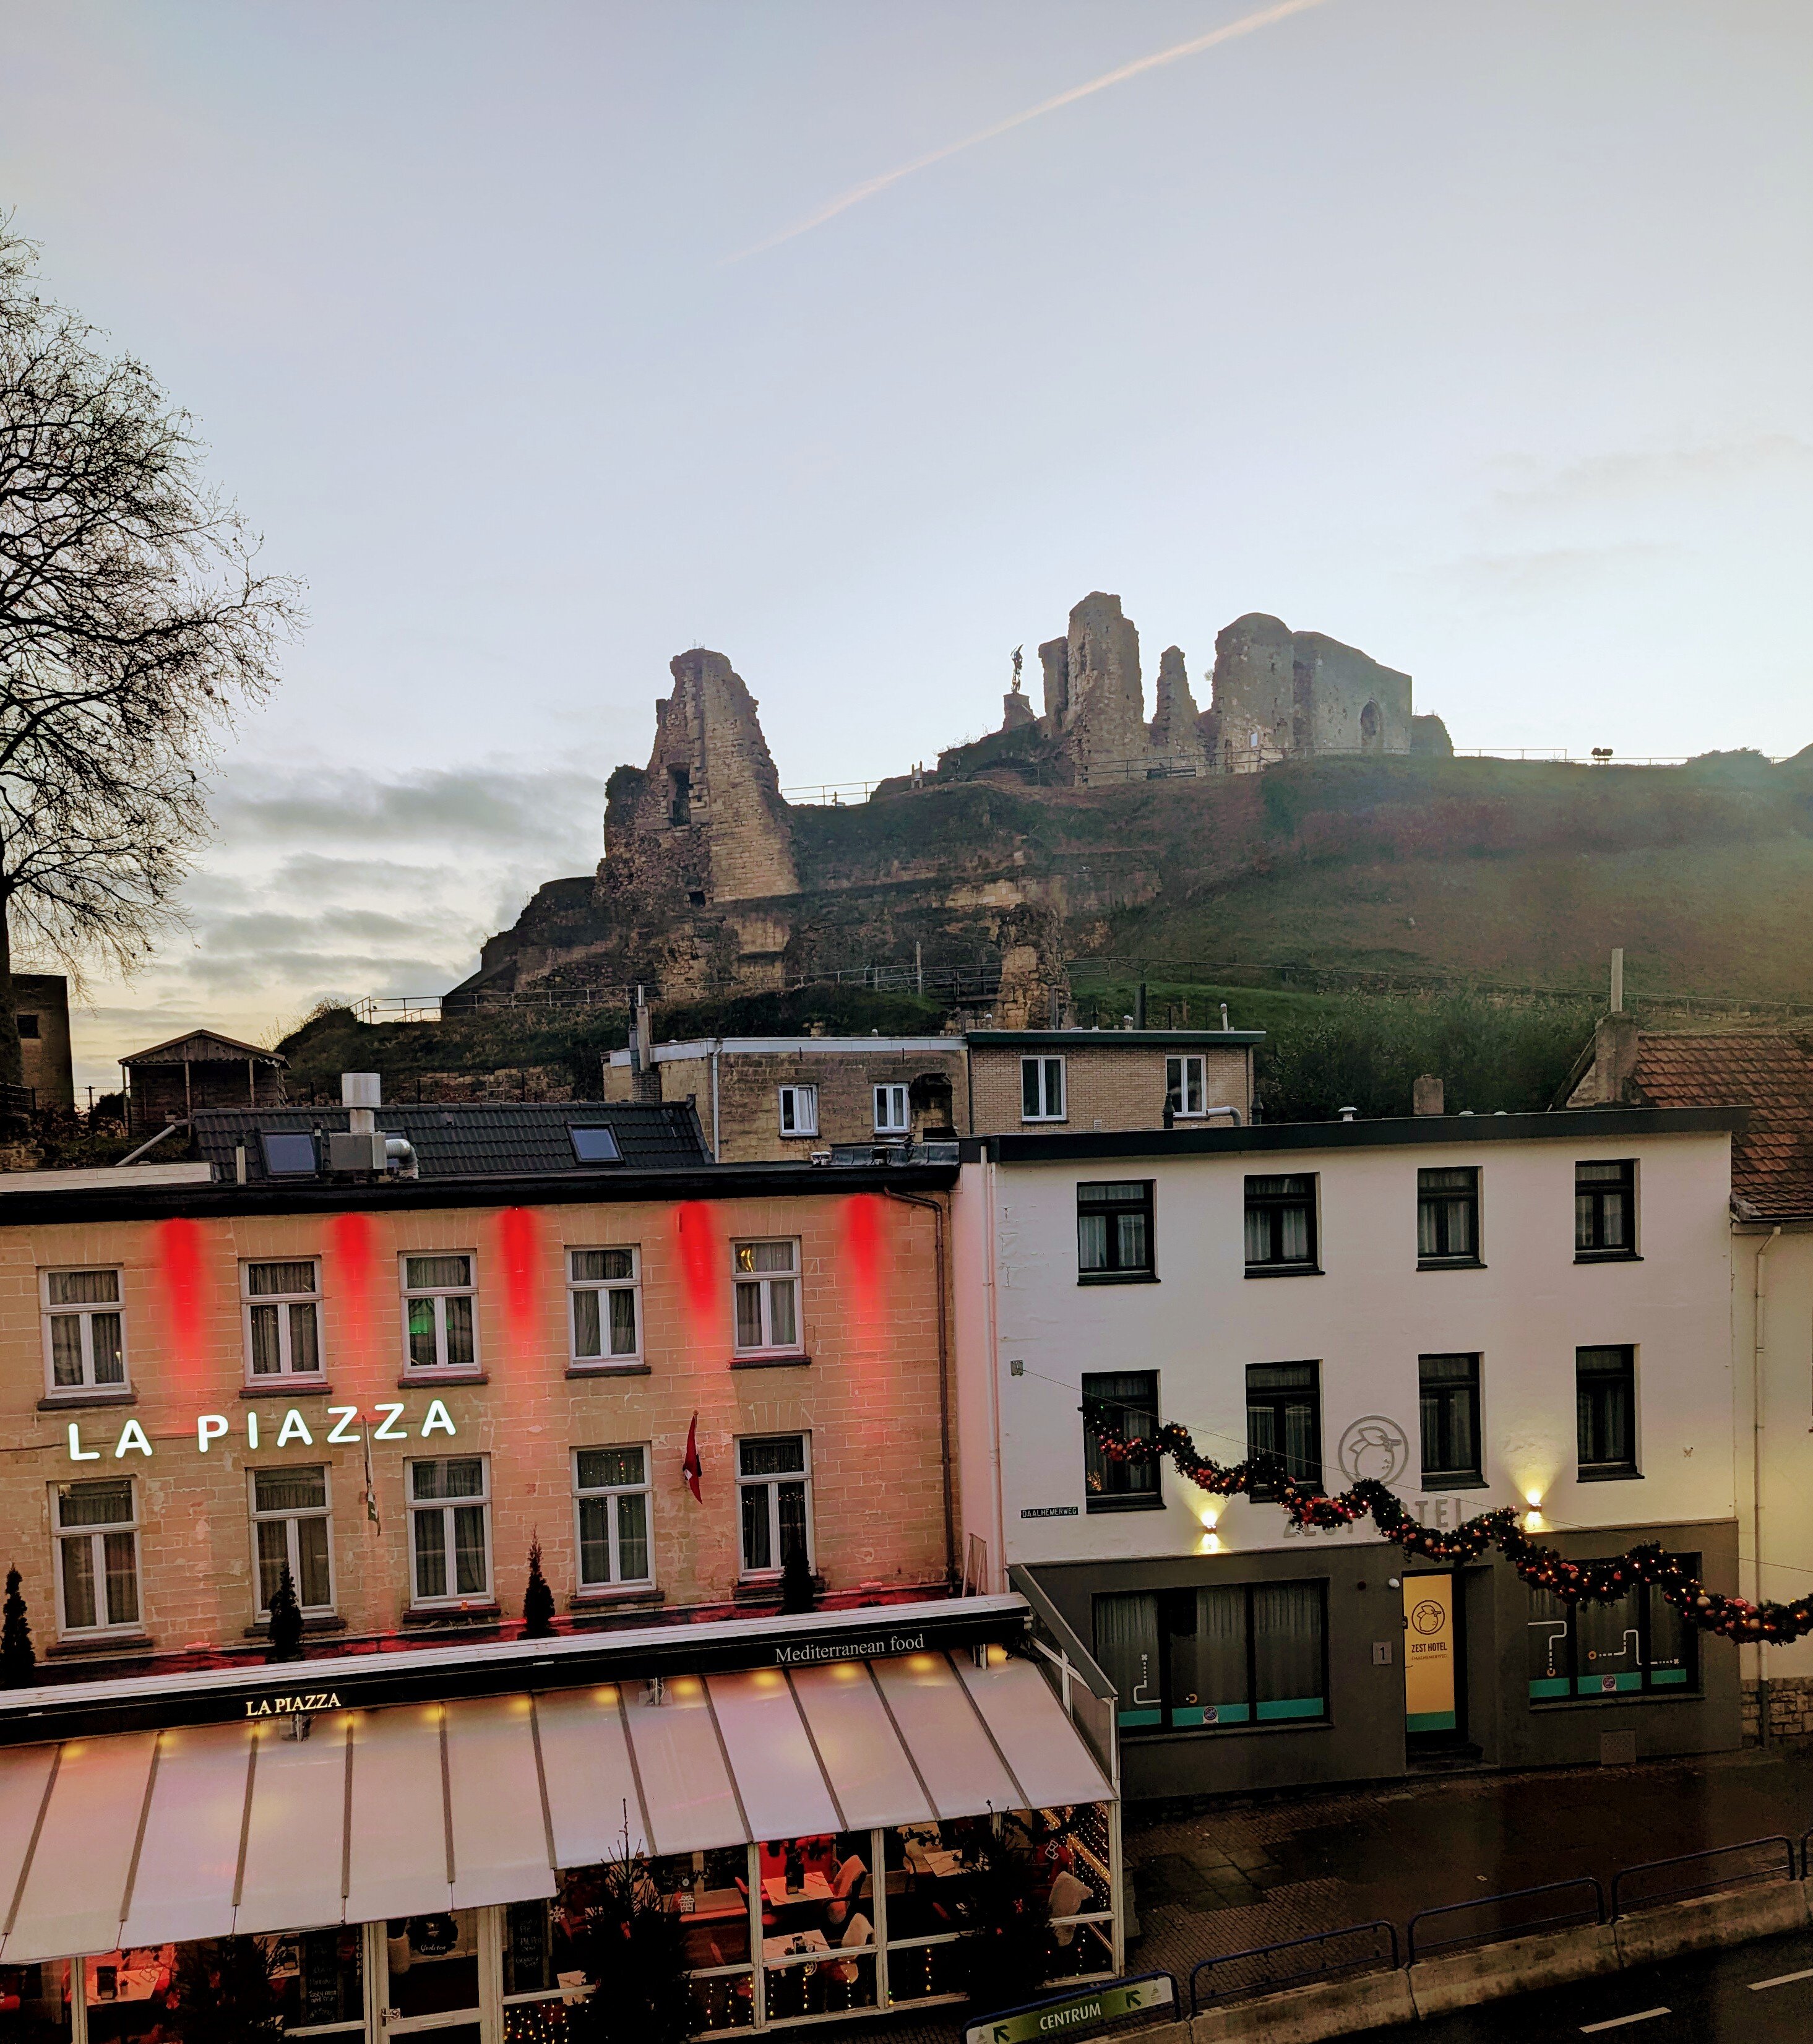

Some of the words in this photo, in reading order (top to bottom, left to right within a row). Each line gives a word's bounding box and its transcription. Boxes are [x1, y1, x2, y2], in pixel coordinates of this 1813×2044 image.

[68, 1419, 153, 1461] LA
[197, 1399, 457, 1453] PIAZZA
[1022, 1507, 1077, 1517] DAALHEMERWEG
[775, 1641, 885, 1663] Mediterranean
[890, 1634, 925, 1651] food
[1380, 1647, 1385, 1660] 1
[1411, 1644, 1426, 1653] ZEST
[1428, 1642, 1447, 1652] HOTEL
[246, 1700, 272, 1716] LA
[275, 1693, 342, 1713] PIAZZA
[1040, 2003, 1101, 2030] CENTRUM
